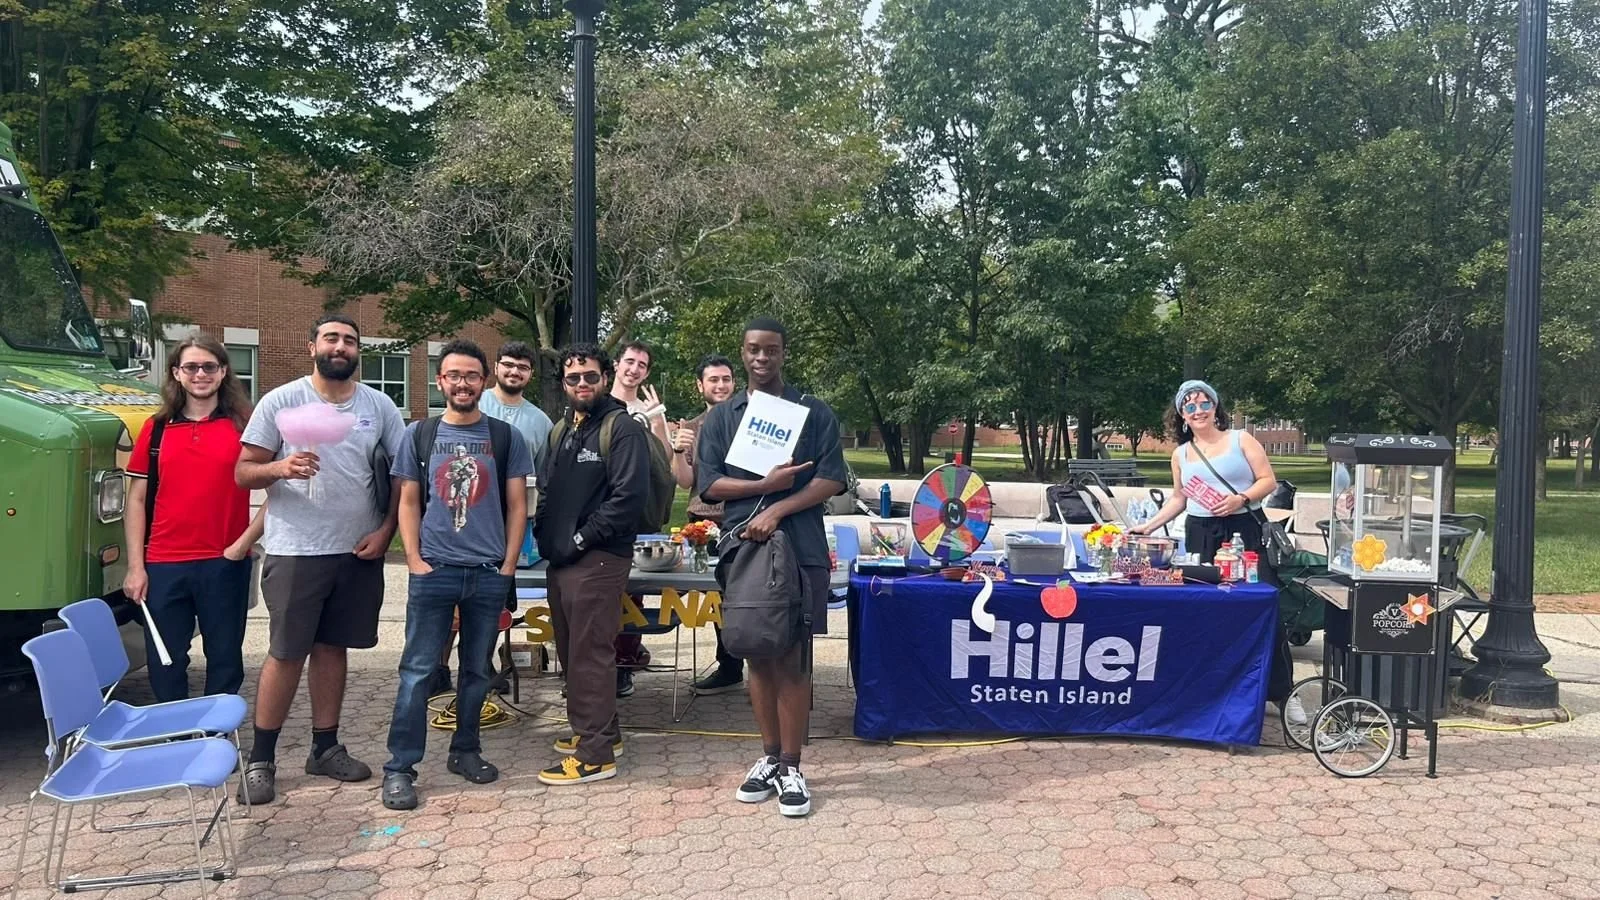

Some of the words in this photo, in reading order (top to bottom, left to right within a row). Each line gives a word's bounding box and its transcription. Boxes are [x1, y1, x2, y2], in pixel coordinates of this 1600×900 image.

[748, 416, 792, 442] Hillel
[950, 618, 1162, 682] Hillel
[970, 684, 1048, 704] Staten
[1059, 686, 1132, 705] Island
